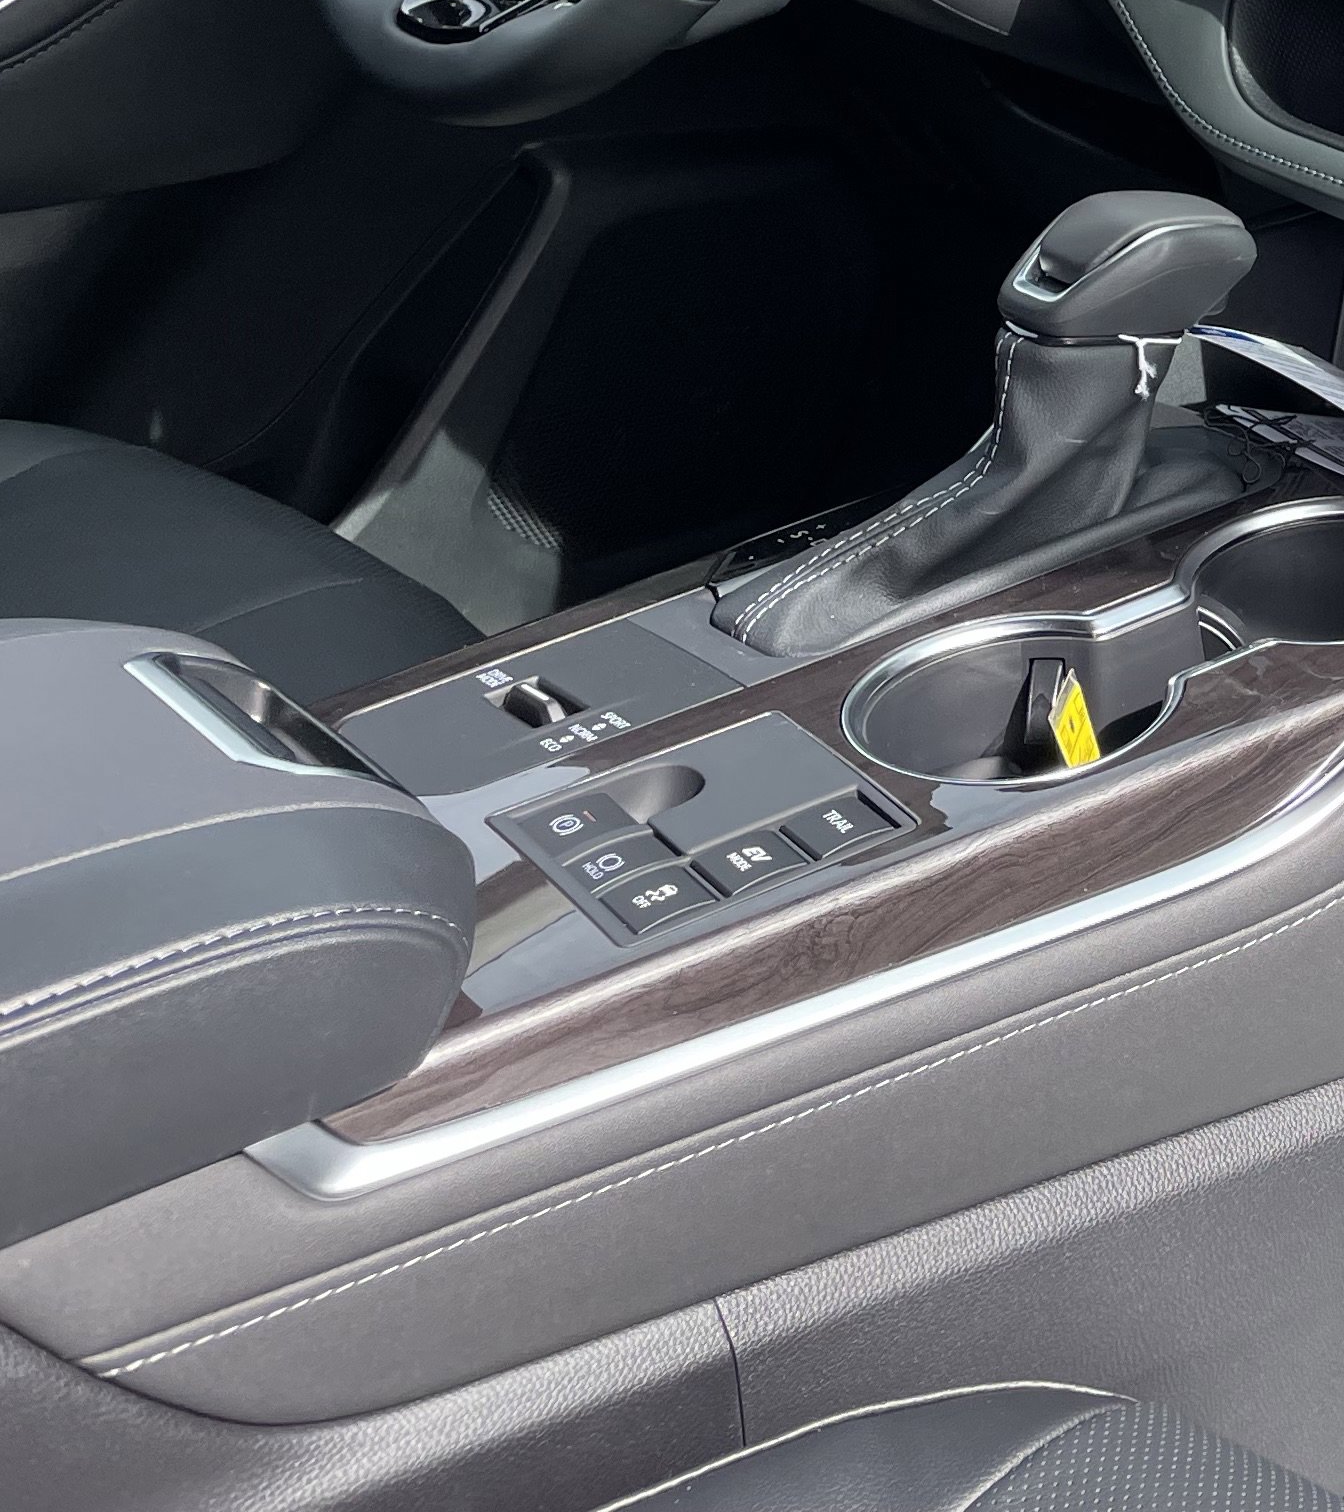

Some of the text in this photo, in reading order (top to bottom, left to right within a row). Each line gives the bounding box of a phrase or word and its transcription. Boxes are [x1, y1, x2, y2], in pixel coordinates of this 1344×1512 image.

[601, 711, 631, 729] SPORT
[822, 808, 854, 834] TRAIL
[726, 851, 751, 873] MODE
[742, 846, 772, 863] EV
[582, 862, 603, 880] HOLD
[631, 895, 652, 909] OFF
